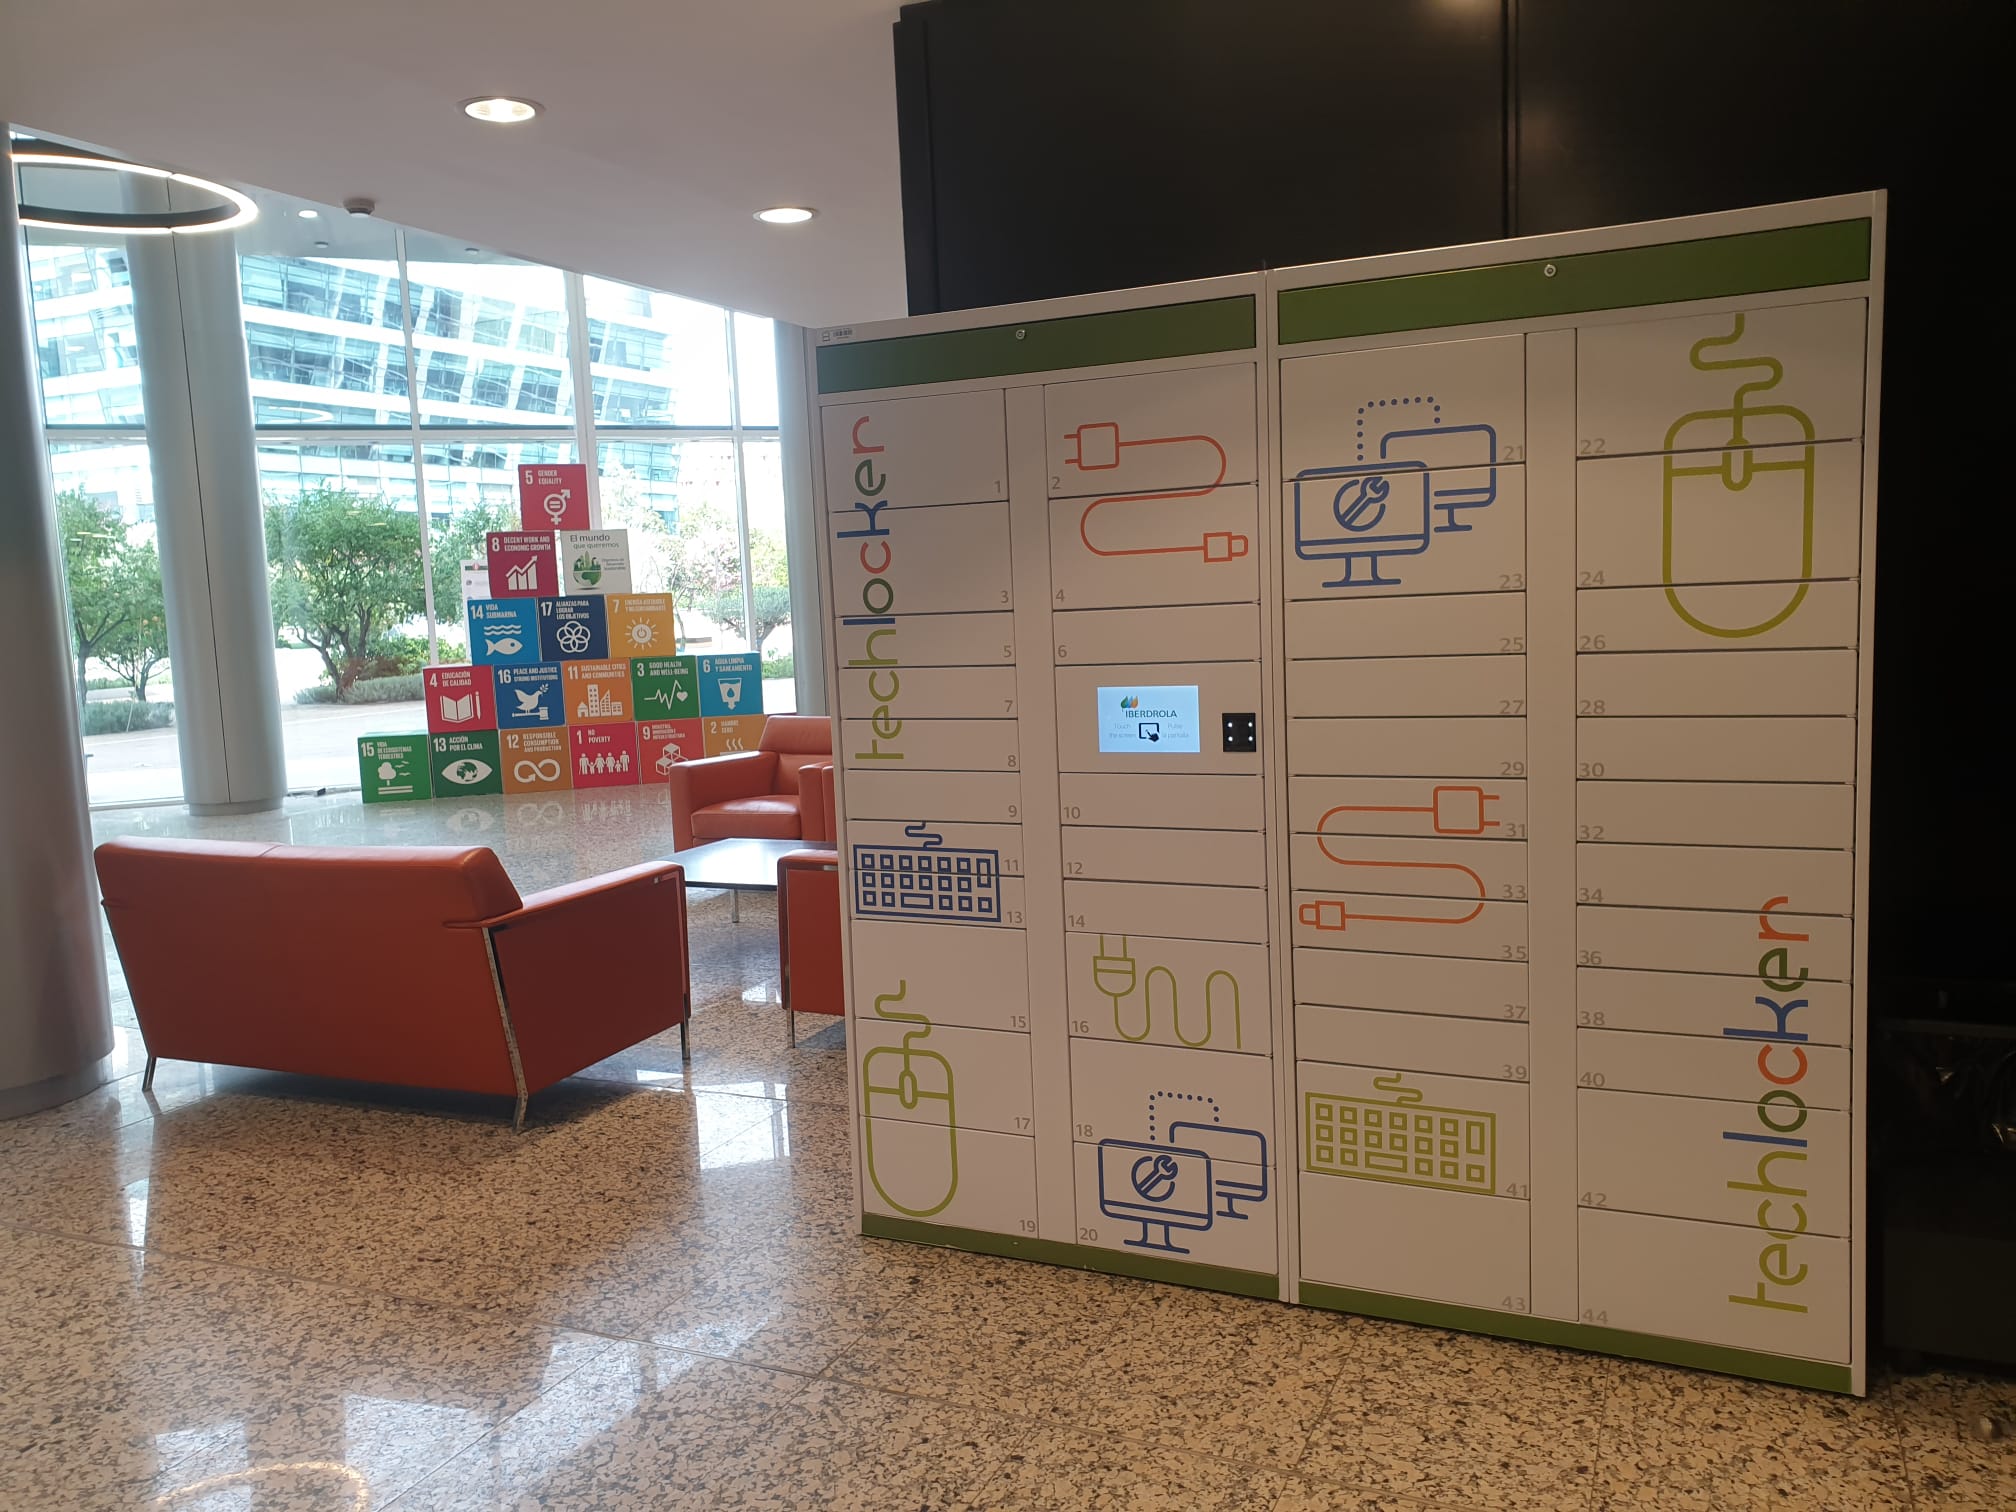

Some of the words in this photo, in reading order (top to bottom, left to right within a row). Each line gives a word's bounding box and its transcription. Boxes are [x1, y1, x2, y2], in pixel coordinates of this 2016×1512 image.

[1504, 445, 1524, 460] 21
[1580, 438, 1605, 454] 22
[525, 470, 533, 484] 5
[1052, 476, 1060, 490] 2
[994, 480, 1002, 494] 1
[492, 538, 500, 552] 8
[580, 534, 610, 542] mundo
[1500, 574, 1524, 588] 23
[1580, 570, 1604, 586] 24
[837, 416, 904, 760] techlocker
[1001, 590, 1009, 604] 3
[1056, 590, 1065, 602] 4
[470, 605, 484, 620] 14
[541, 602, 552, 616] 17
[612, 600, 620, 614] 7
[1500, 637, 1524, 652] 25
[1580, 634, 1606, 650] 26
[1003, 646, 1012, 658] 5
[1058, 645, 1067, 658] 6
[568, 666, 578, 680] 11
[637, 663, 644, 677] 3
[703, 660, 710, 673] 6
[430, 673, 438, 687] 4
[442, 671, 470, 679] EDUCACIÓN
[498, 670, 512, 684] 16
[1004, 700, 1012, 712] 7
[1500, 700, 1524, 714] 27
[1580, 700, 1606, 714] 28
[1126, 710, 1178, 718] IBERDROLA
[643, 726, 650, 740] 9
[710, 722, 717, 734] 2
[506, 734, 519, 748] 12
[524, 738, 559, 746] CONSUMPTION
[576, 730, 582, 744] 1
[588, 736, 610, 744] POVERTY
[361, 742, 374, 757] 15
[433, 738, 446, 752] 13
[1008, 755, 1016, 768] 8
[1500, 762, 1524, 776] 29
[1579, 762, 1604, 777] 30
[1008, 805, 1017, 818] 9
[1064, 806, 1080, 820] 10
[1506, 823, 1526, 838] 31
[1580, 825, 1604, 840] 32
[1004, 860, 1018, 872] 11
[1066, 862, 1083, 874] 12
[1502, 884, 1526, 900] 33
[1579, 888, 1604, 902] 34
[1007, 912, 1022, 924] 13
[1068, 915, 1085, 928] 14
[1502, 945, 1526, 960] 35
[1579, 950, 1602, 965] 36
[1504, 1004, 1526, 1019] 37
[1580, 1011, 1605, 1026] 38
[1010, 1016, 1026, 1028] 15
[1072, 1020, 1089, 1033] 16
[1502, 1064, 1526, 1080] 39
[1580, 1072, 1605, 1086] 40
[1723, 896, 1809, 1313] techlocker
[1014, 1117, 1030, 1130] 17
[1076, 1124, 1093, 1137] 18
[1506, 1183, 1528, 1198] 41
[1581, 1192, 1607, 1207] 42
[1020, 1220, 1036, 1232] 19
[1080, 1228, 1098, 1242] 20
[1502, 1296, 1526, 1312] 43
[1583, 1309, 1608, 1324] 44
